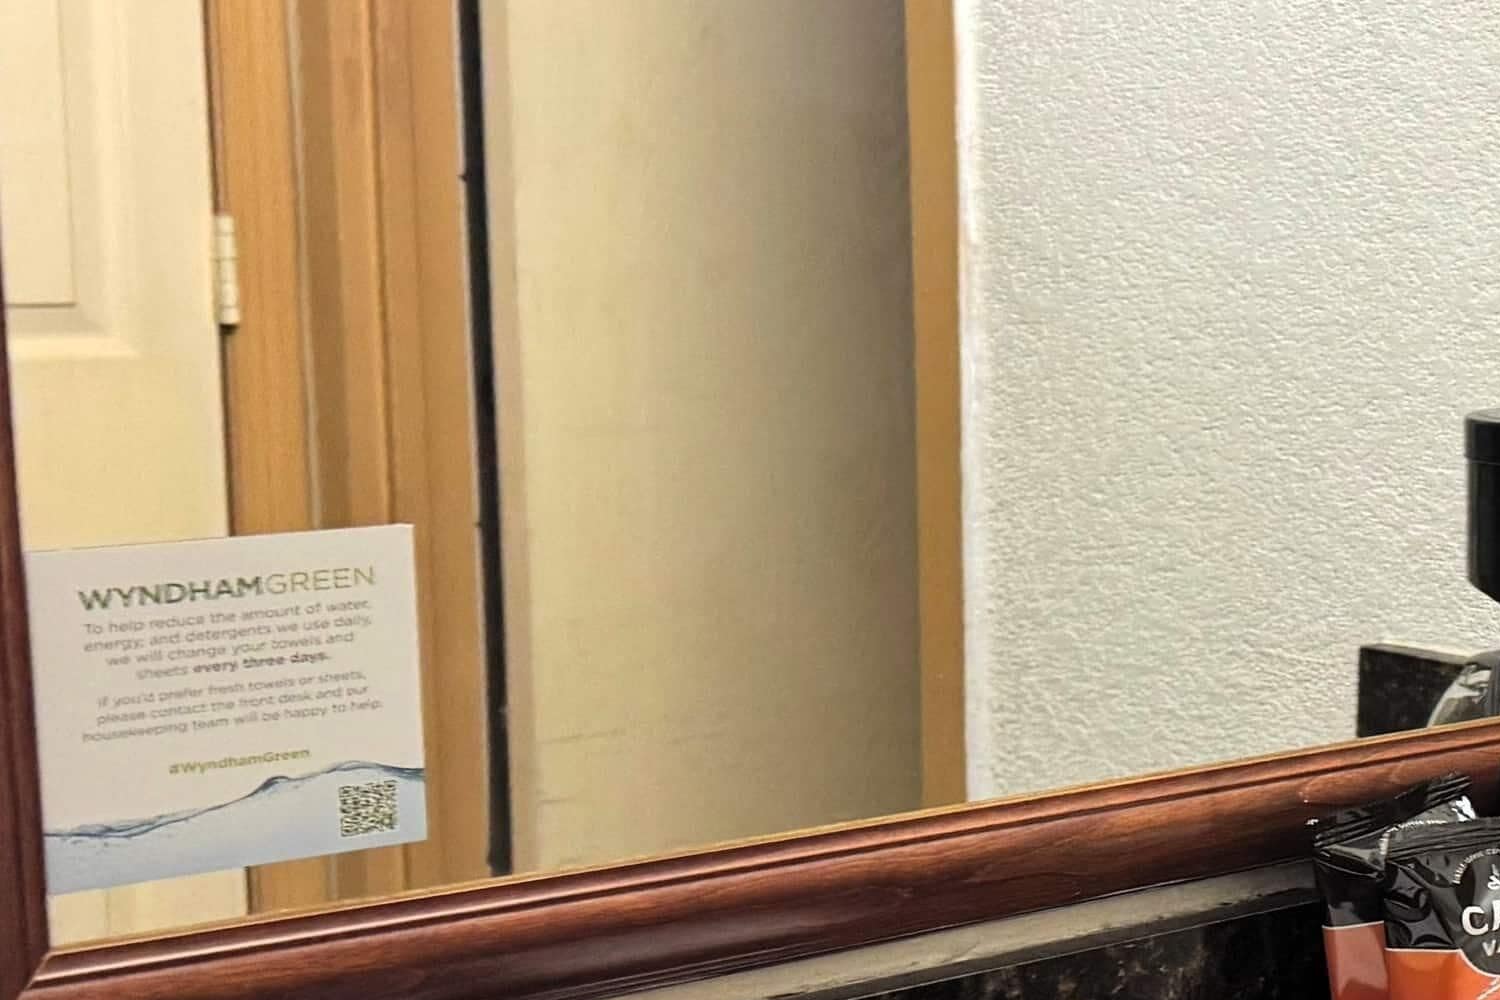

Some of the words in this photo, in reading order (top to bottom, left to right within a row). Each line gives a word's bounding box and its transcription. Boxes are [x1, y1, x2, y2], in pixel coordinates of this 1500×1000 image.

[78, 565, 375, 610] WYNDHAMGREEN
[83, 639, 144, 653] energy,
[149, 633, 180, 646] and
[185, 624, 271, 643] detergents
[276, 623, 298, 633] we
[303, 620, 330, 631] use
[333, 614, 372, 628] daily,
[84, 623, 103, 635] To
[108, 620, 144, 633] help
[150, 615, 205, 629] reduce
[210, 612, 236, 623] the
[241, 605, 300, 621] amount
[305, 602, 322, 615] of
[106, 656, 131, 666] we
[136, 650, 163, 663] will
[167, 645, 226, 661] change
[231, 641, 267, 657] your
[271, 634, 322, 649] towels
[325, 631, 354, 644] and
[136, 665, 188, 681] sheets
[192, 660, 238, 673] every
[242, 654, 286, 669] three
[290, 651, 332, 665] days.
[96, 710, 145, 726] please
[150, 702, 208, 719] contact
[211, 700, 235, 712] the
[238, 694, 275, 707] front
[278, 691, 312, 704] desk
[315, 687, 342, 700] and
[346, 685, 368, 697] our
[98, 695, 108, 708] If
[113, 691, 155, 708] you'd
[157, 687, 203, 703] prefer
[207, 682, 244, 695] fresh
[248, 677, 296, 691] towels
[299, 675, 315, 686] or
[318, 670, 367, 683] sheets,
[82, 721, 188, 743] housekeeping
[192, 717, 229, 731] team
[234, 711, 258, 725] will
[262, 709, 280, 721] be
[283, 705, 327, 720] happy
[331, 702, 346, 713] to
[350, 697, 383, 711] help.
